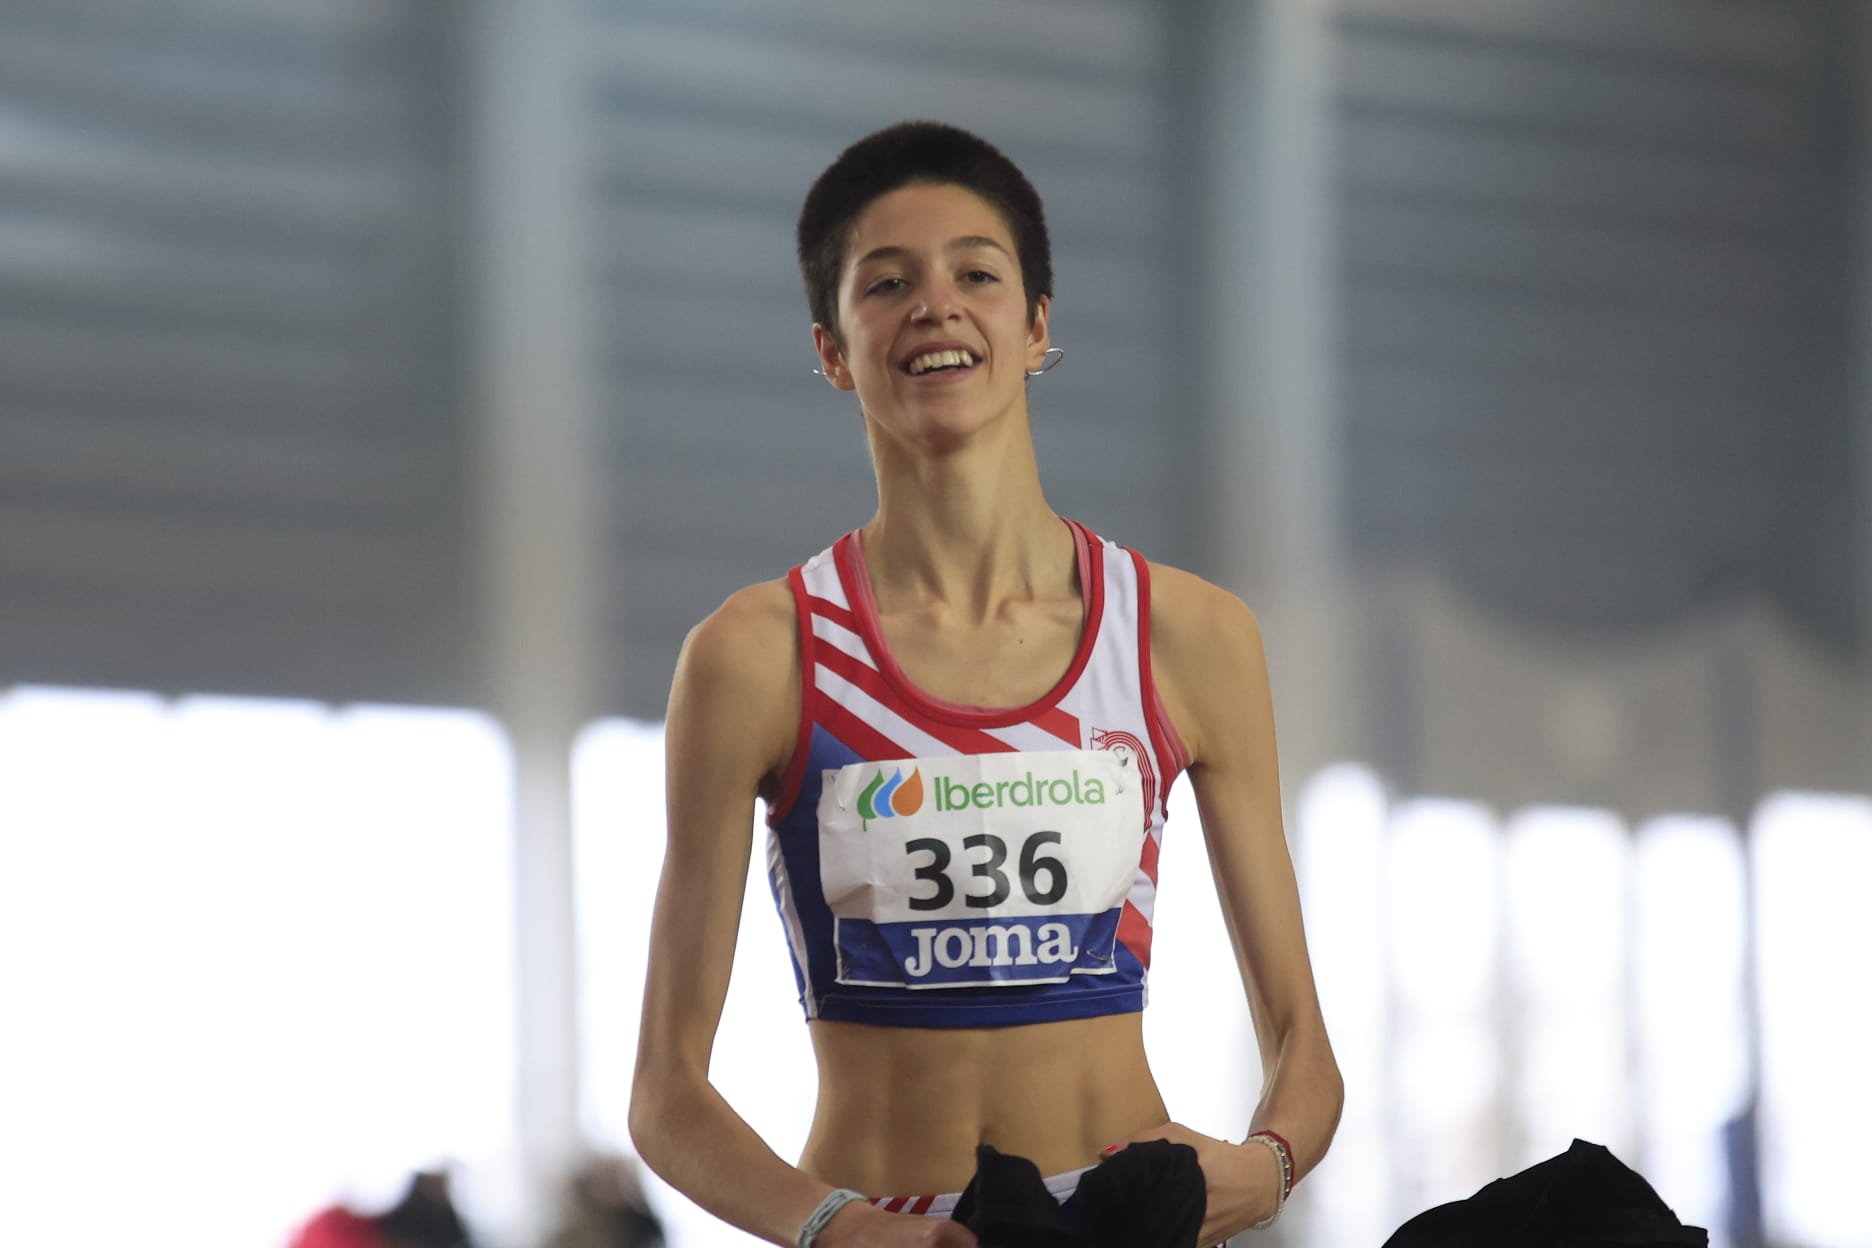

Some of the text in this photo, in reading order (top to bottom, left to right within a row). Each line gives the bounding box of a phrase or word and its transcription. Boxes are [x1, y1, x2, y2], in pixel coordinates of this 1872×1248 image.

[934, 770, 1105, 812] Iberdrola
[905, 831, 1068, 911] 336
[905, 922, 1078, 977] Joma
